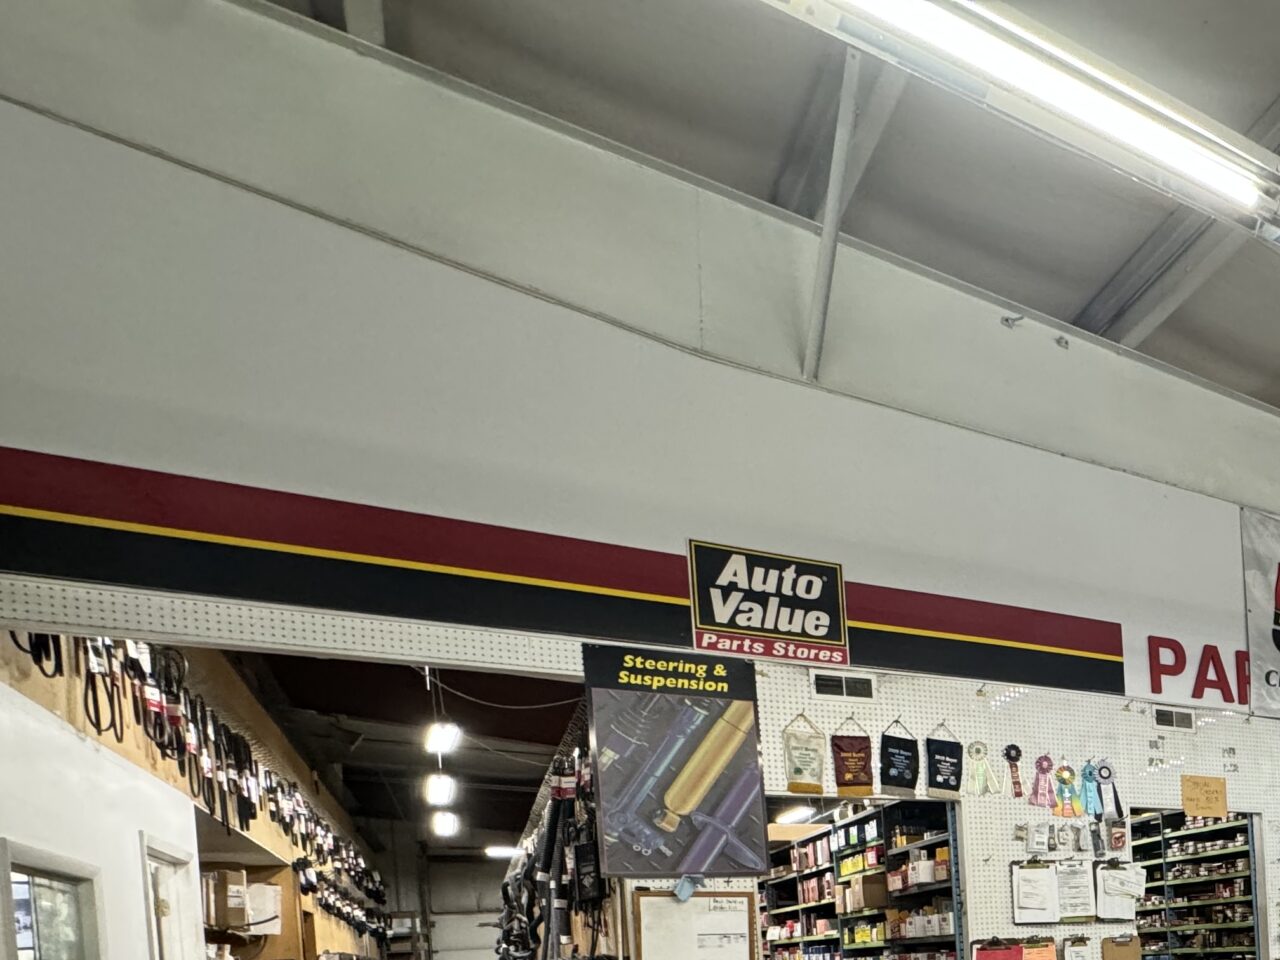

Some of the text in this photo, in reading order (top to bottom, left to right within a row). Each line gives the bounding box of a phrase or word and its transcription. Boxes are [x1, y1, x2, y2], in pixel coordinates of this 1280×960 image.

[715, 554, 823, 599] Auto
[709, 587, 831, 636] Value
[701, 634, 844, 663] Parts Stores
[623, 655, 727, 678] Steering &
[618, 671, 729, 692] Suspension
